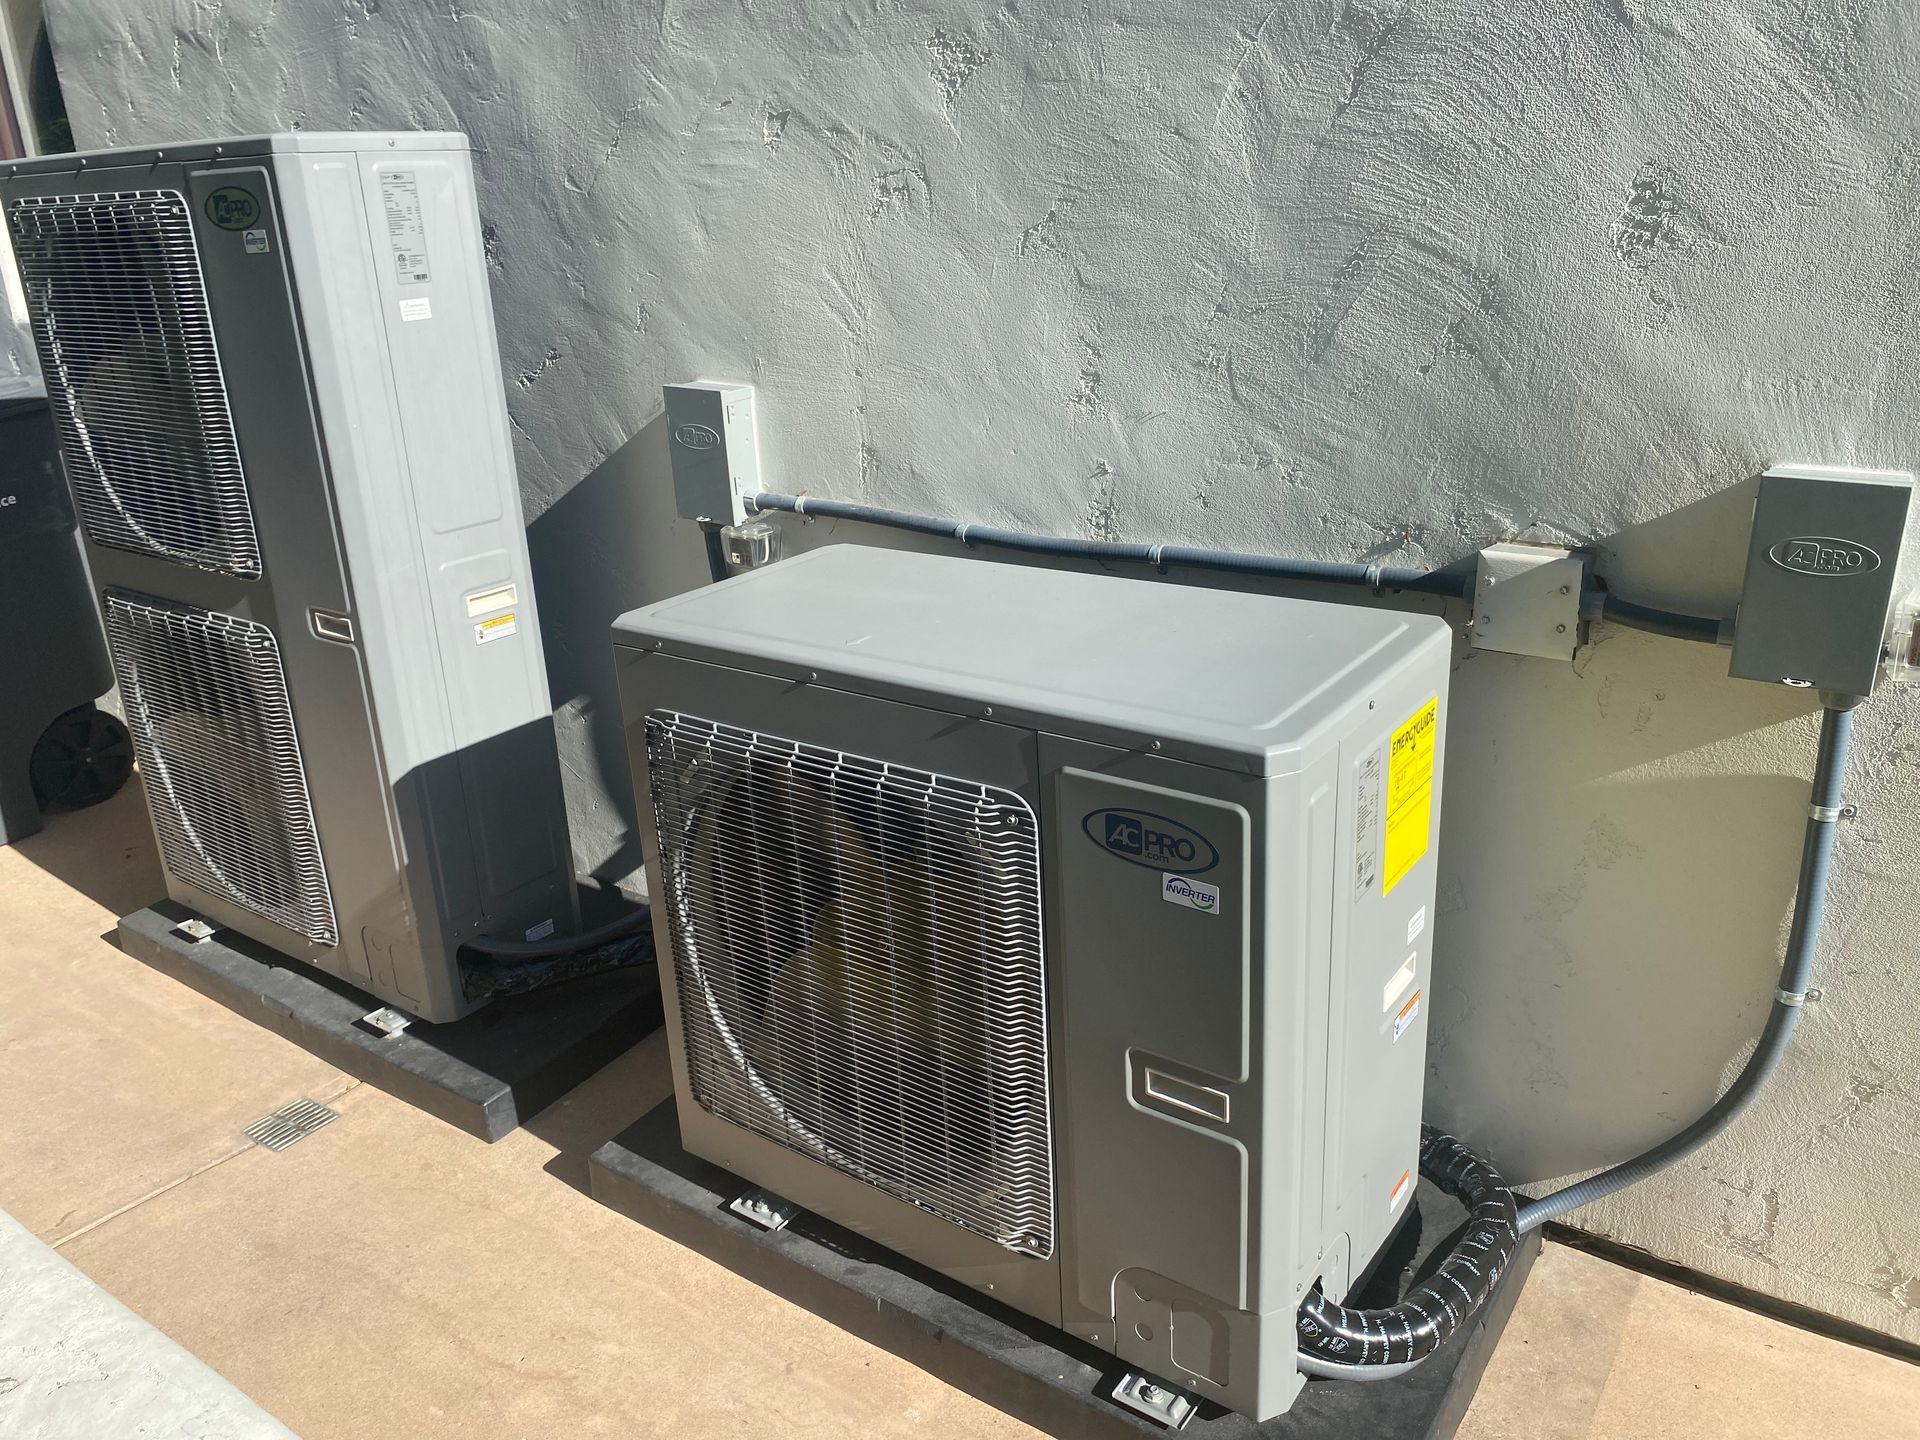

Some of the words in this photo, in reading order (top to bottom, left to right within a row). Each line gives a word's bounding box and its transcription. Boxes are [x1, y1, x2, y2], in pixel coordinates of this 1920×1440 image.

[0, 495, 17, 508] ce
[1144, 829, 1196, 862] PRO
[1144, 852, 1169, 864] .com
[1165, 883, 1216, 905] INVERTER
[1451, 1278, 1472, 1303] COMPANY
[1439, 1298, 1446, 1306] H.
[1421, 1310, 1428, 1318] H.
